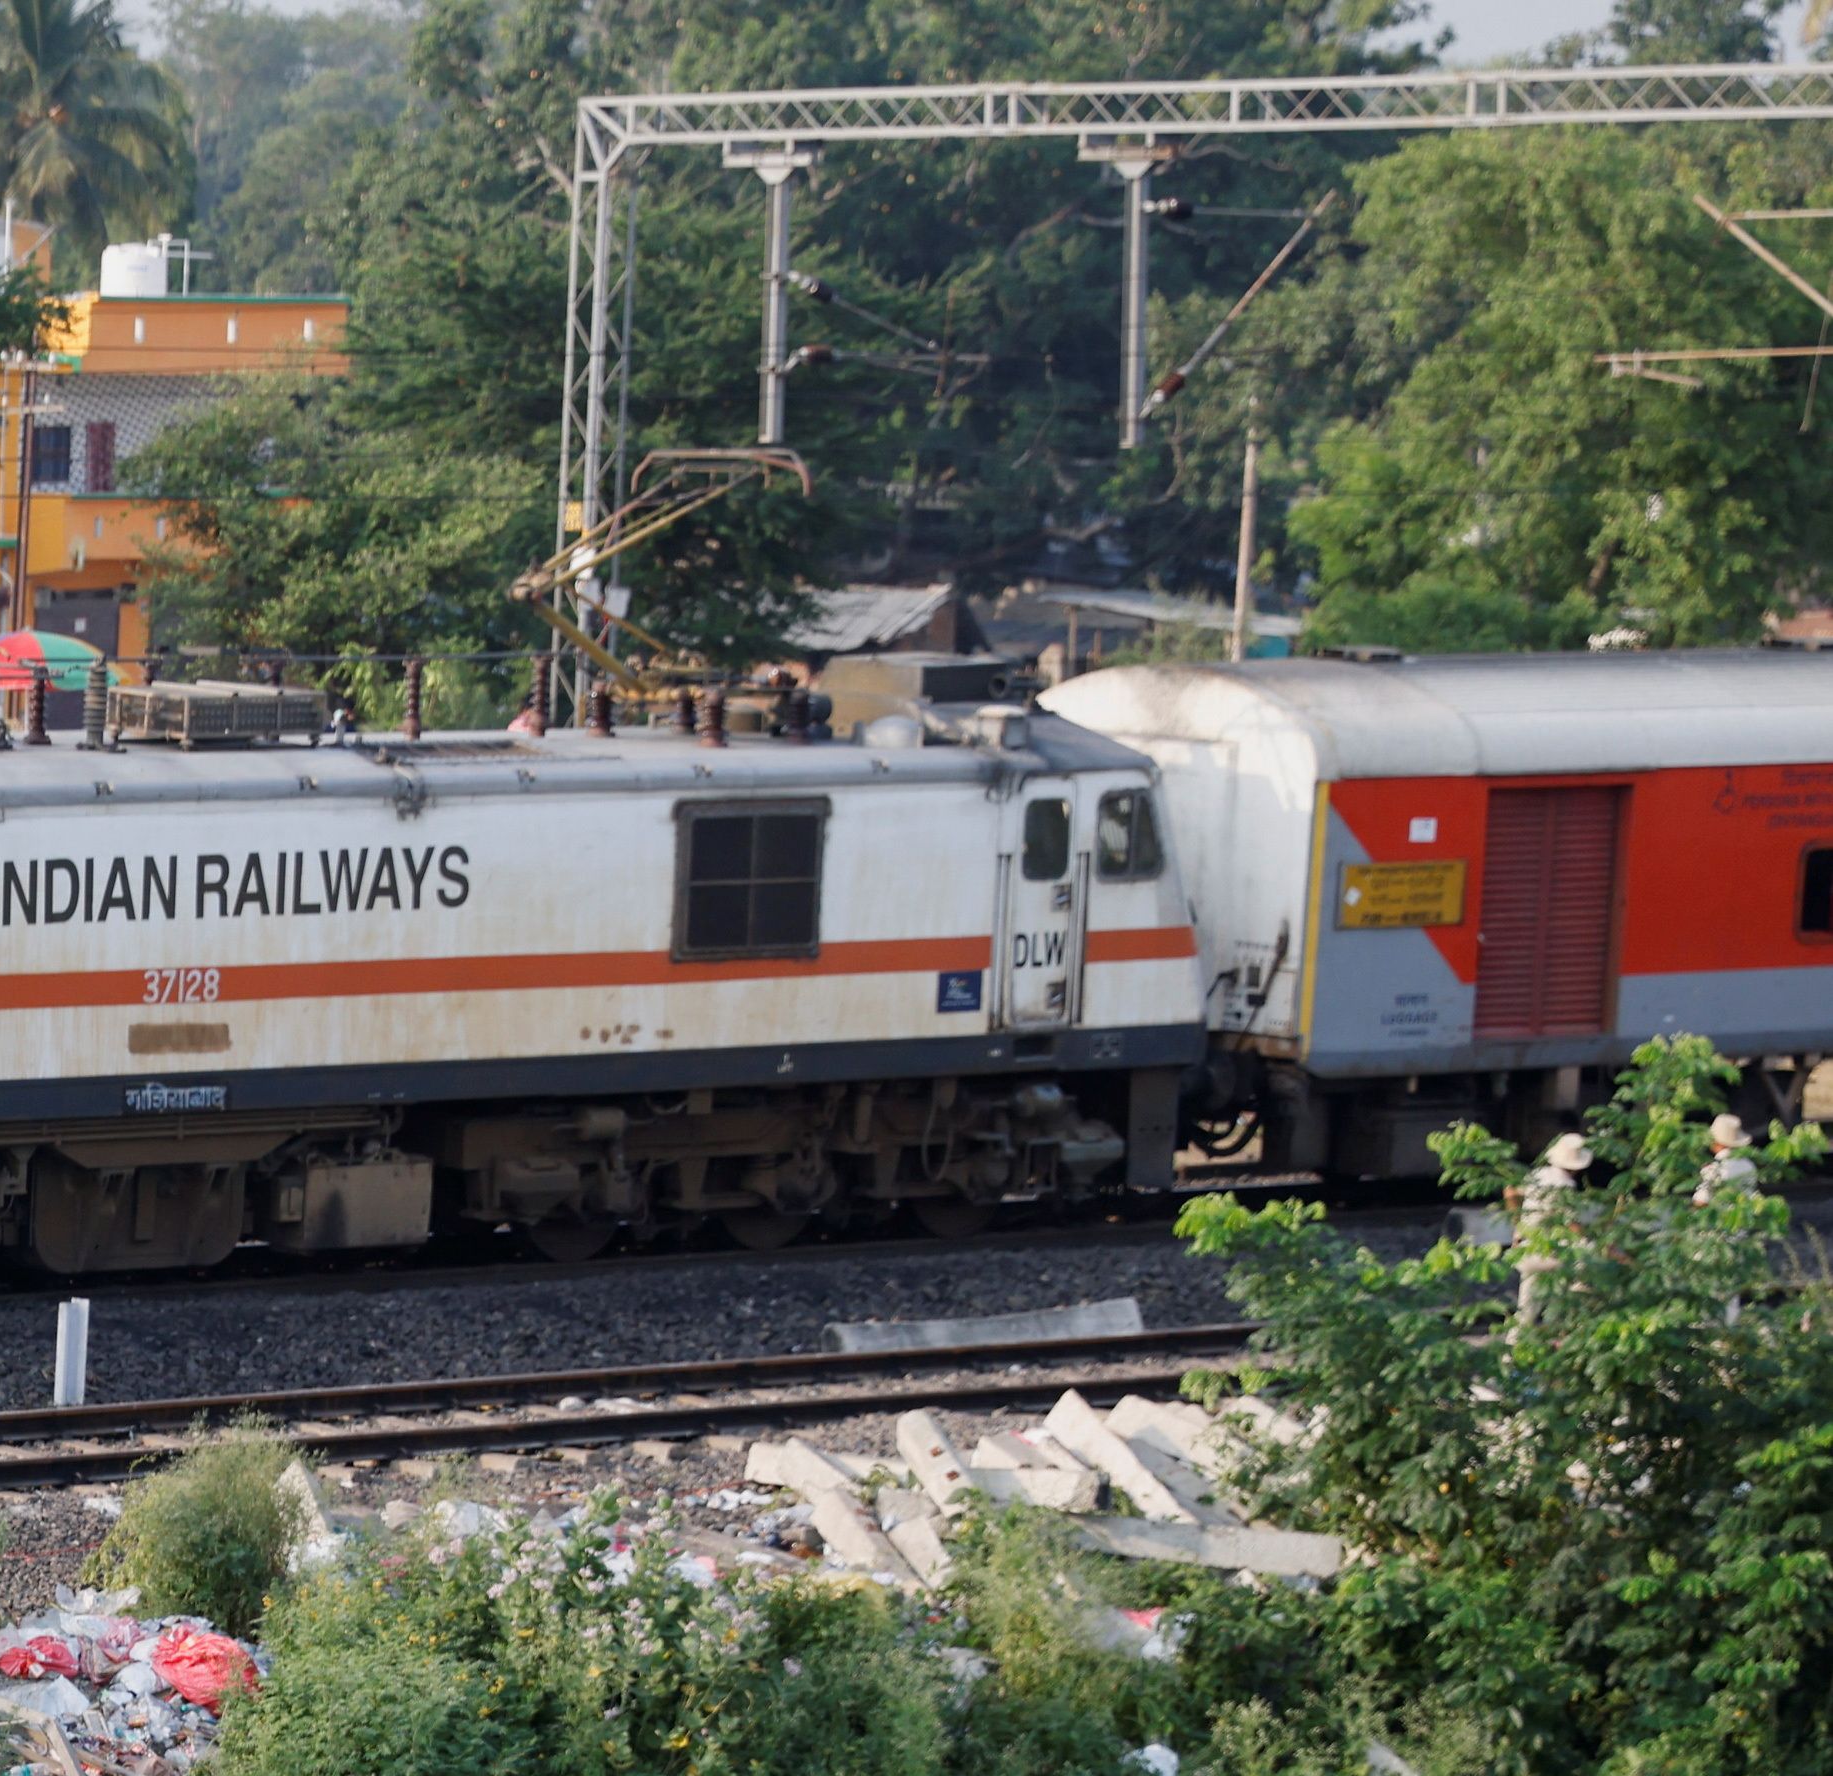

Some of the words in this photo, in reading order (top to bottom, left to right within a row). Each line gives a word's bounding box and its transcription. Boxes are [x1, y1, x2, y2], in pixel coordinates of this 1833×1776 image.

[196, 846, 470, 919] RAILWAYS
[1014, 931, 1066, 969] DLW
[142, 967, 221, 1004] 37128
